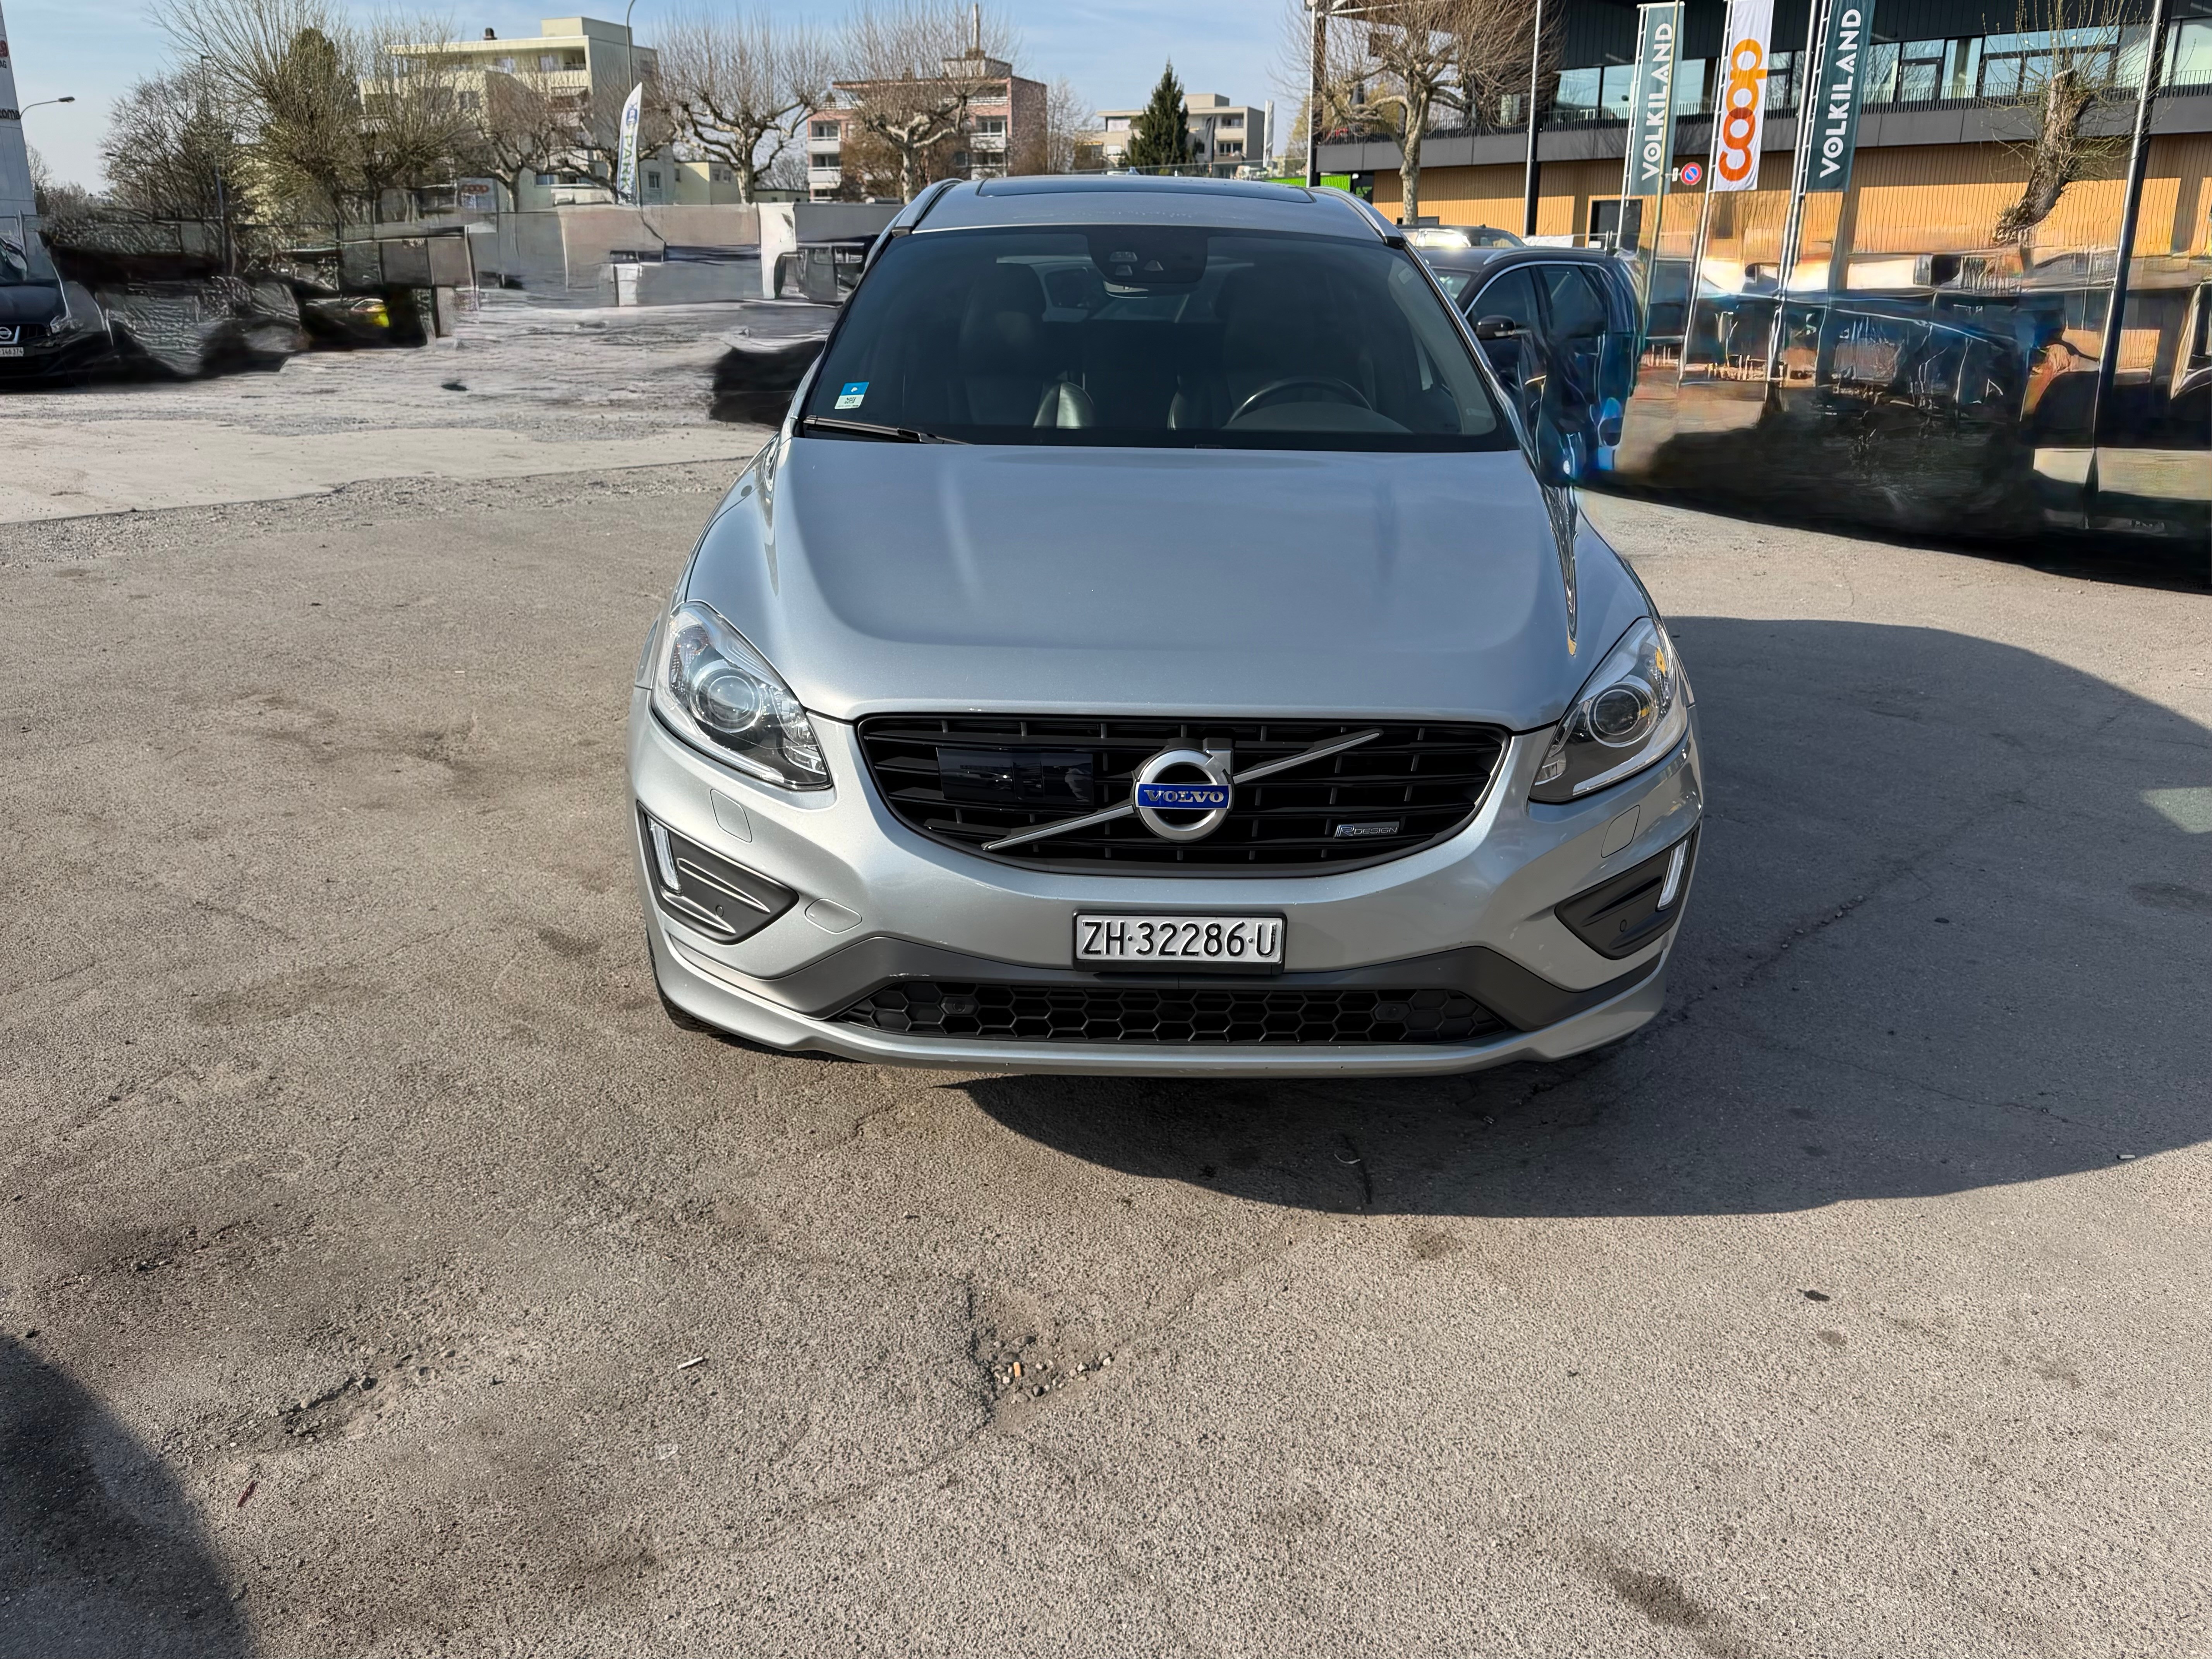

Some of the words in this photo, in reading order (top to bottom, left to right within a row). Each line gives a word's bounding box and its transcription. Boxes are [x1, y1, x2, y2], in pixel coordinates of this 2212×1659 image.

[1641, 23, 1673, 181] VOLKILAND
[1719, 39, 1767, 181] coop
[1819, 9, 1861, 178] VOLKILAND
[1144, 790, 1224, 802] VOLVO
